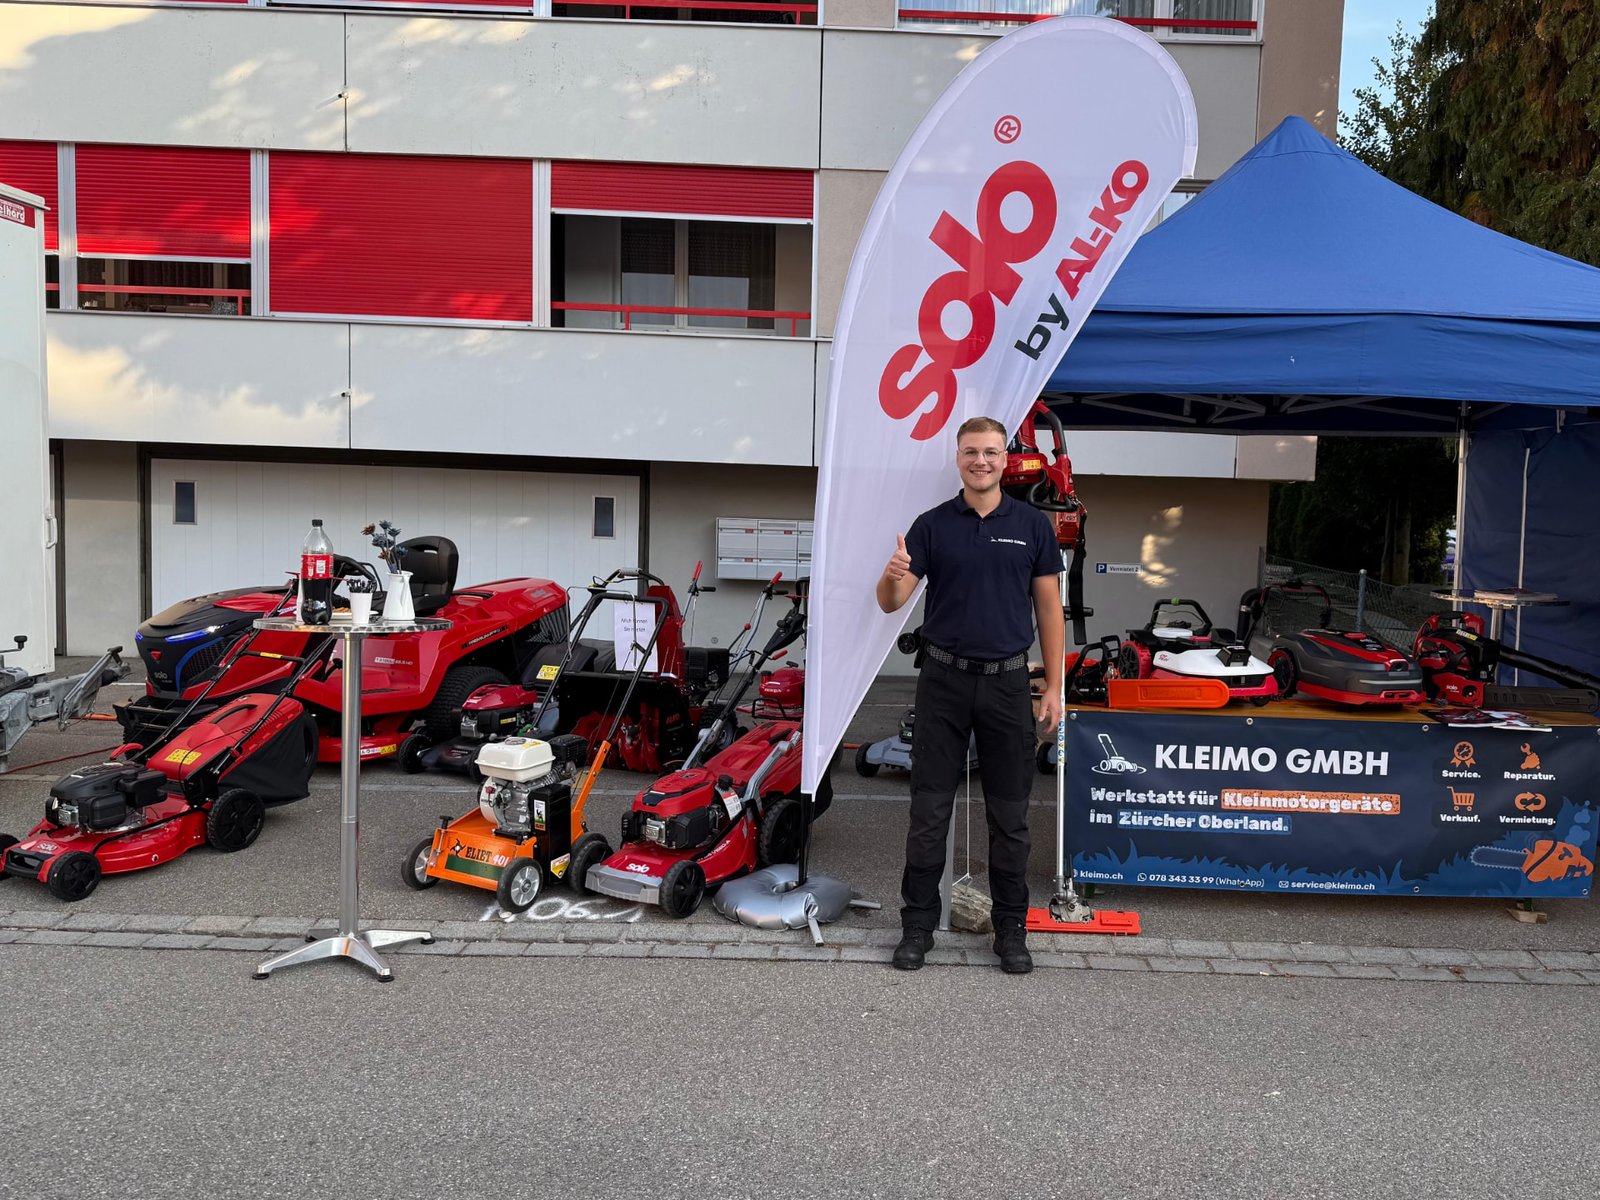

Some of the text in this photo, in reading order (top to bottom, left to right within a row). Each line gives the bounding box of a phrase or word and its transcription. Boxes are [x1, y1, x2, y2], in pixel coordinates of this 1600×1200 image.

[1014, 160, 1149, 361] by AL-KO
[879, 160, 1058, 441] solo
[1155, 744, 1389, 776] KLEIMO GMBH
[1441, 769, 1482, 779] Service.
[1503, 771, 1556, 781] Reparatur.
[1090, 787, 1393, 814] Werkstatt für Kleinmotorgeräte
[1089, 808, 1289, 832] im Zürcher Oberland.
[1439, 813, 1481, 823] Verkauf.
[1499, 815, 1556, 826] Vermietung.
[465, 846, 493, 862] ELIET
[625, 863, 650, 873] solo
[1080, 870, 1124, 880] kleimo.ch
[1148, 874, 1167, 882] 078
[1168, 874, 1187, 883] 343
[1202, 876, 1215, 884] 99
[1291, 880, 1376, 890] service@kleimo.ch
